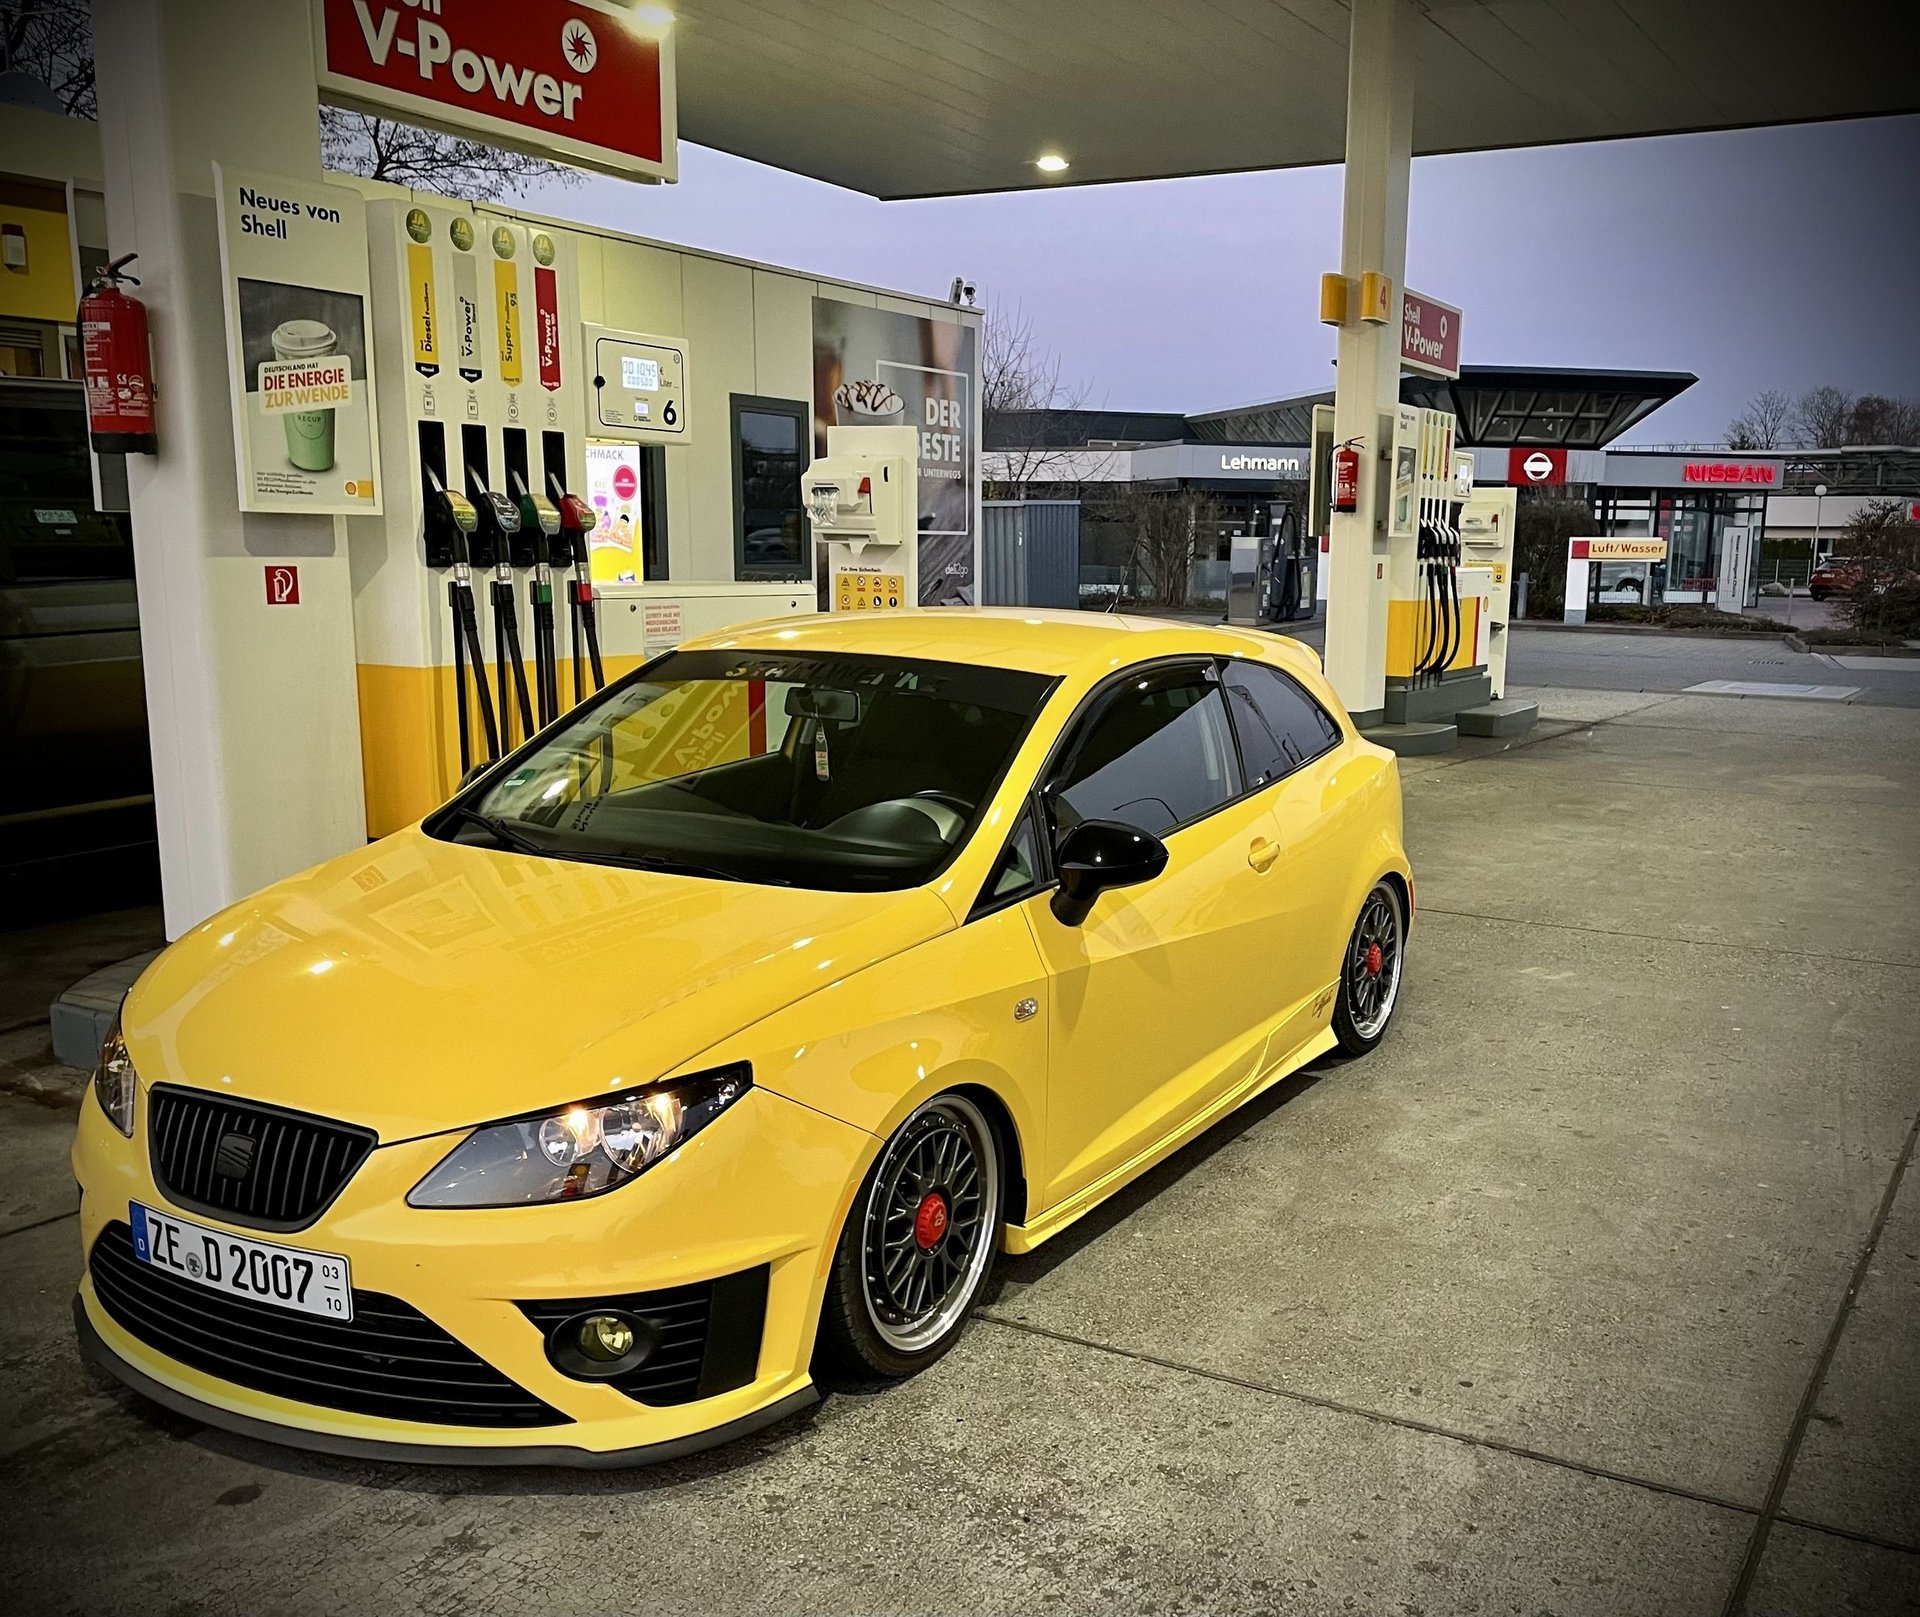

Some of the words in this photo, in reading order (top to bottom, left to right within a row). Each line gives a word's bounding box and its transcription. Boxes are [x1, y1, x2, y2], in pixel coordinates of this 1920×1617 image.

[353, 0, 583, 122] V-Power
[239, 186, 301, 216] Neues
[306, 204, 340, 224] von
[240, 213, 287, 240] Shell
[510, 292, 518, 307] 95
[1380, 286, 1386, 310] 4
[1404, 302, 1421, 326] Shell
[423, 316, 432, 352] Diesel
[464, 300, 474, 357] V-Power
[544, 312, 554, 368] V-Power
[505, 326, 514, 362] Super
[1404, 324, 1444, 360] V-Power
[264, 364, 306, 374] DEUTSCHLAND
[264, 374, 285, 392] DIE
[288, 368, 345, 388] ENERGIE
[265, 392, 294, 408] ZUR
[295, 385, 348, 404] WENDE
[663, 400, 677, 426] 6
[926, 397, 962, 428] DER
[924, 468, 962, 480] UNTERWEGS
[1221, 454, 1299, 471] Lehmann
[1684, 462, 1776, 483] NISSAN
[1592, 543, 1664, 554] Luft/Wasser
[138, 1238, 146, 1251] D
[148, 1216, 185, 1271] ZE
[202, 1236, 222, 1283] D
[229, 1244, 314, 1304] 2007
[322, 1264, 339, 1280] 03
[326, 1298, 342, 1312] 10
